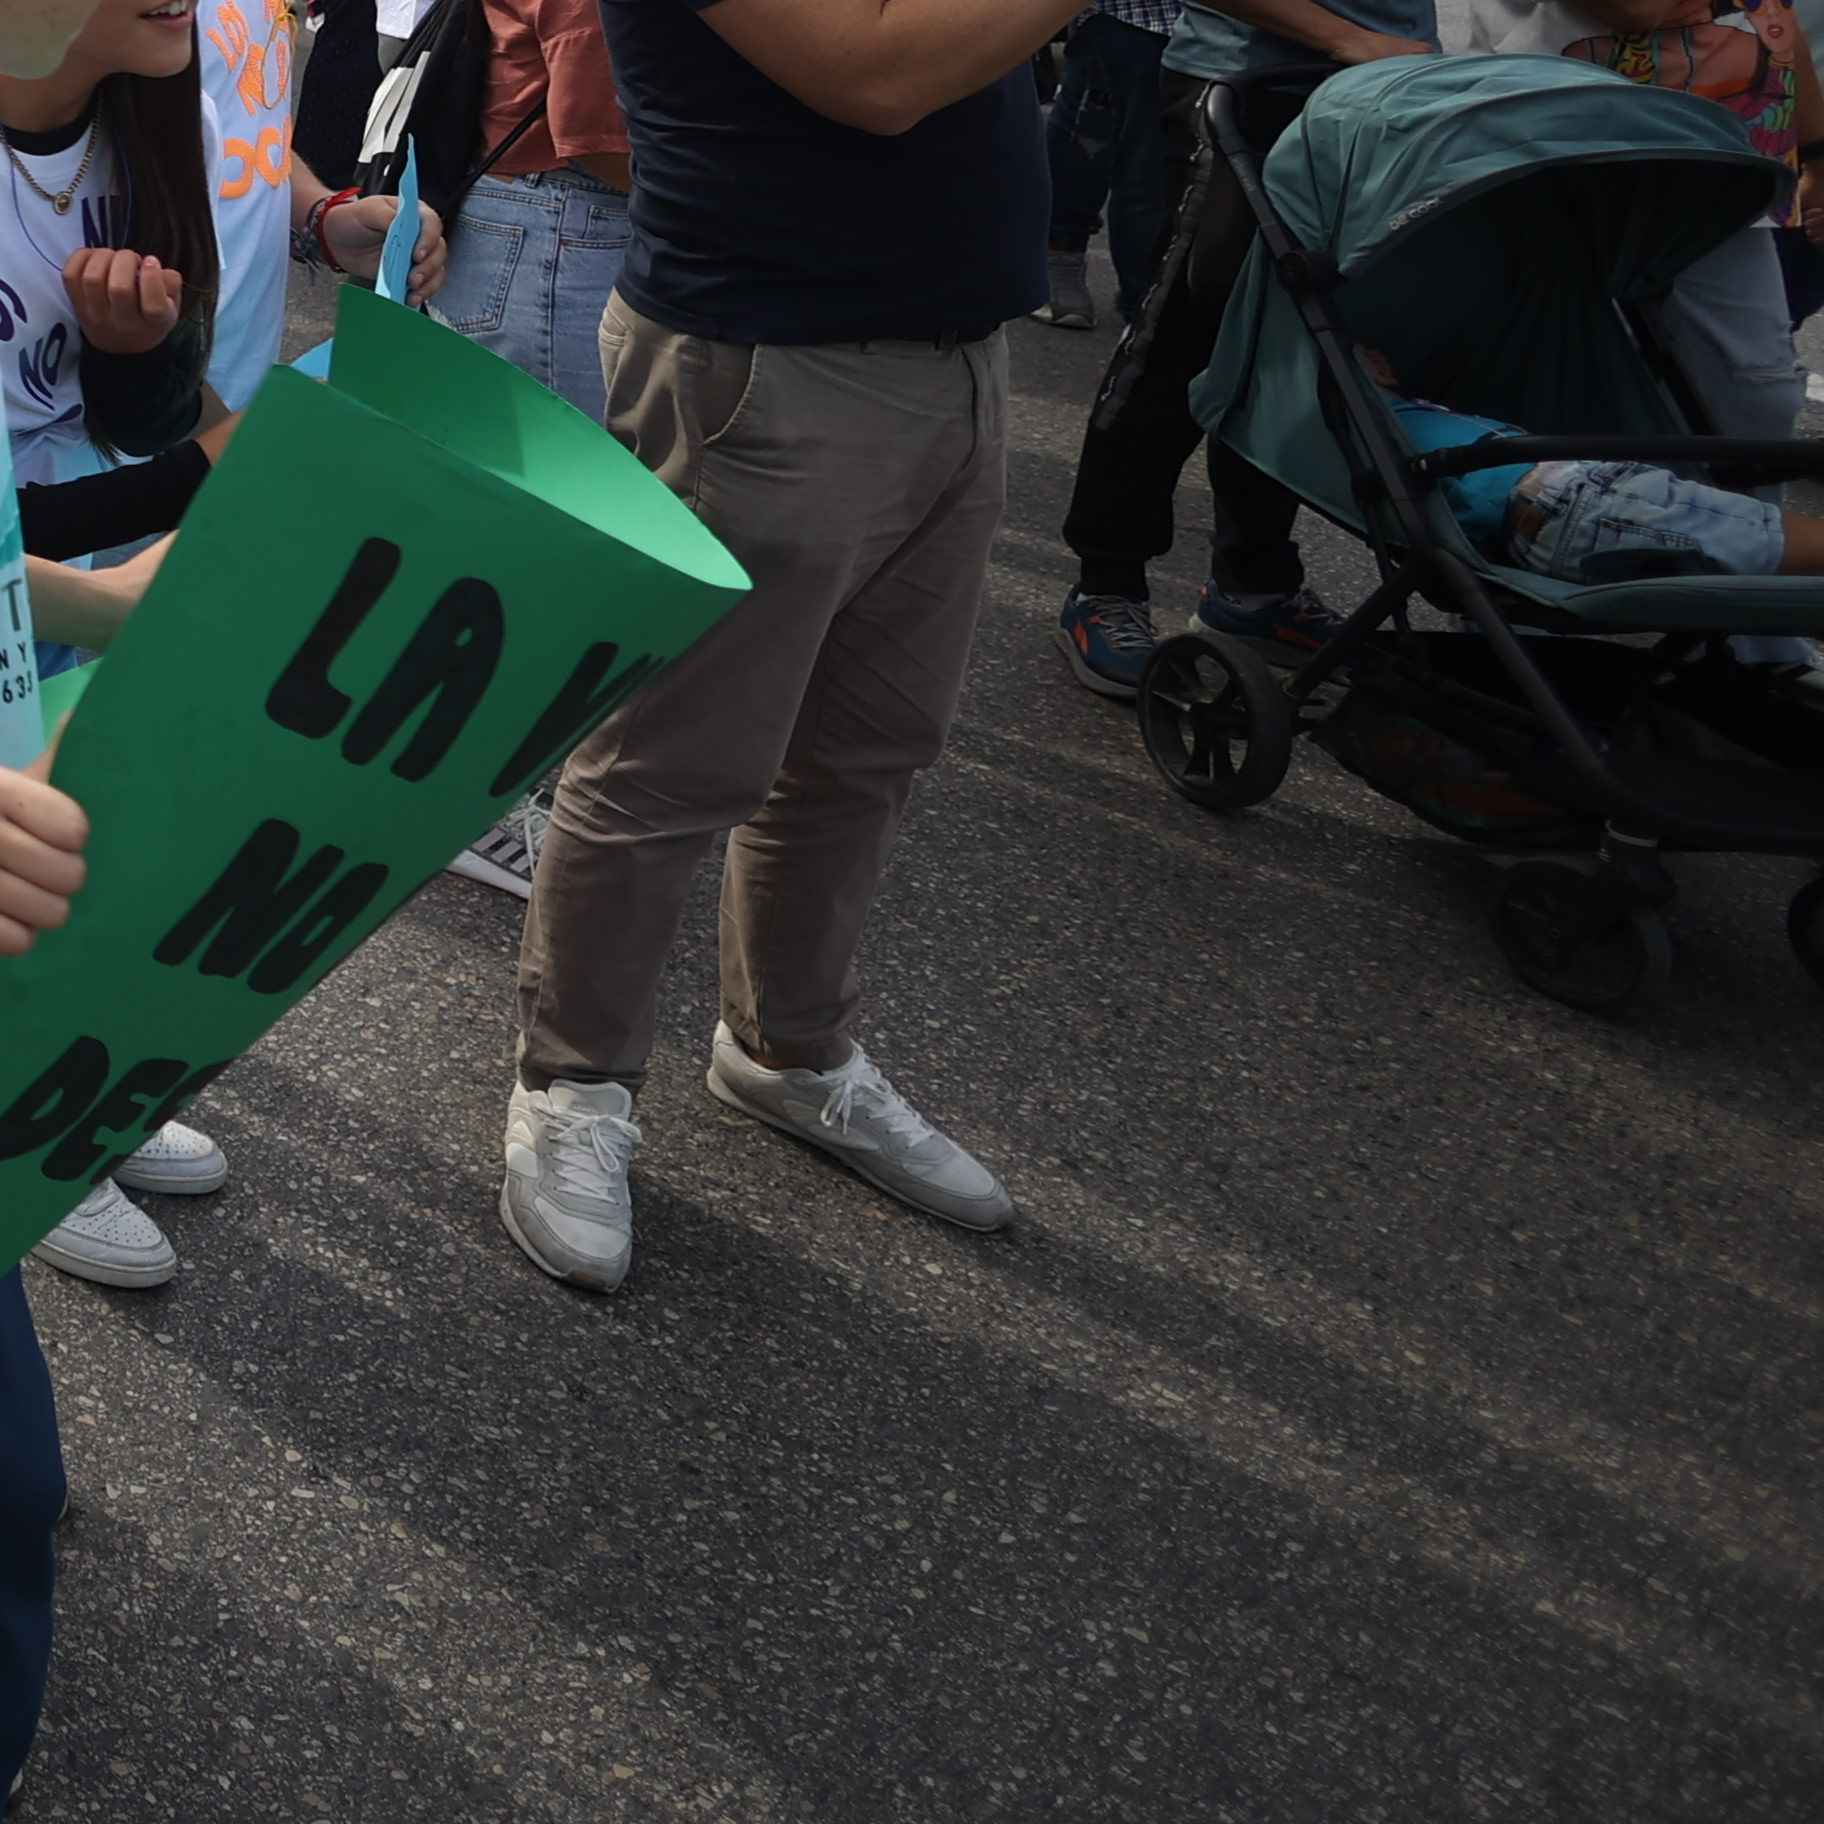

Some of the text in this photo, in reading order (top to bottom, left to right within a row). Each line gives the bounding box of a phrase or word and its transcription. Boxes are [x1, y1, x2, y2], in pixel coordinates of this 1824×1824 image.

[18, 322, 68, 411] NO
[264, 537, 507, 783] LA
[152, 817, 389, 995] NO
